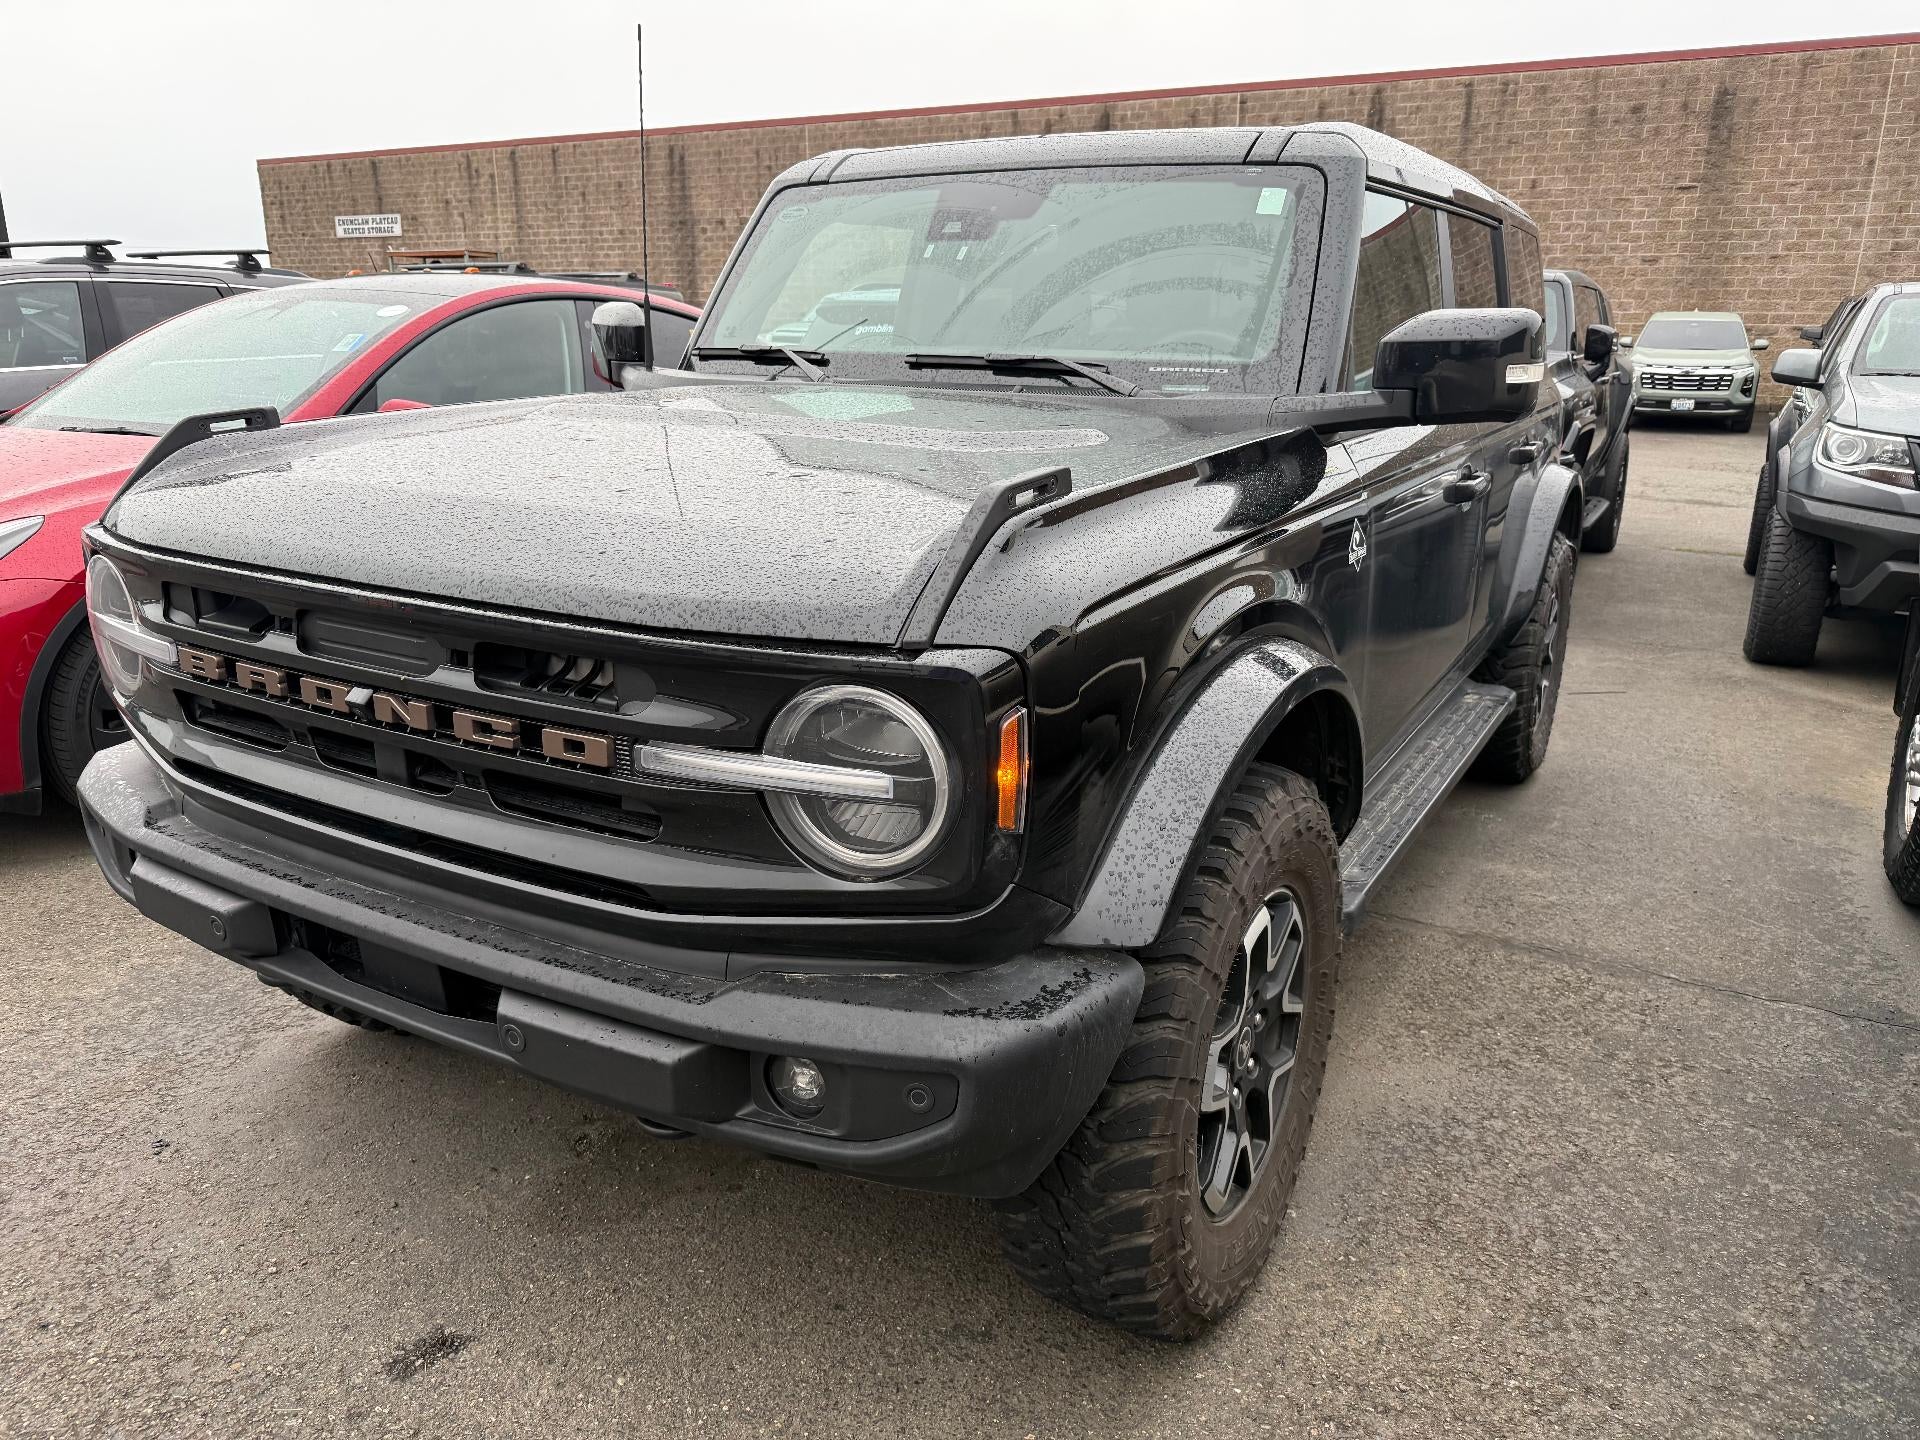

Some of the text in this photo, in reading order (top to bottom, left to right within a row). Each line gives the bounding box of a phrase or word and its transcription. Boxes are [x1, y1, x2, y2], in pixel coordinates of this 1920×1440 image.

[337, 216, 398, 227] ENUMCLAW PLATEAU
[343, 226, 394, 235] HEATED STORAGE
[178, 646, 616, 768] BRONCO
